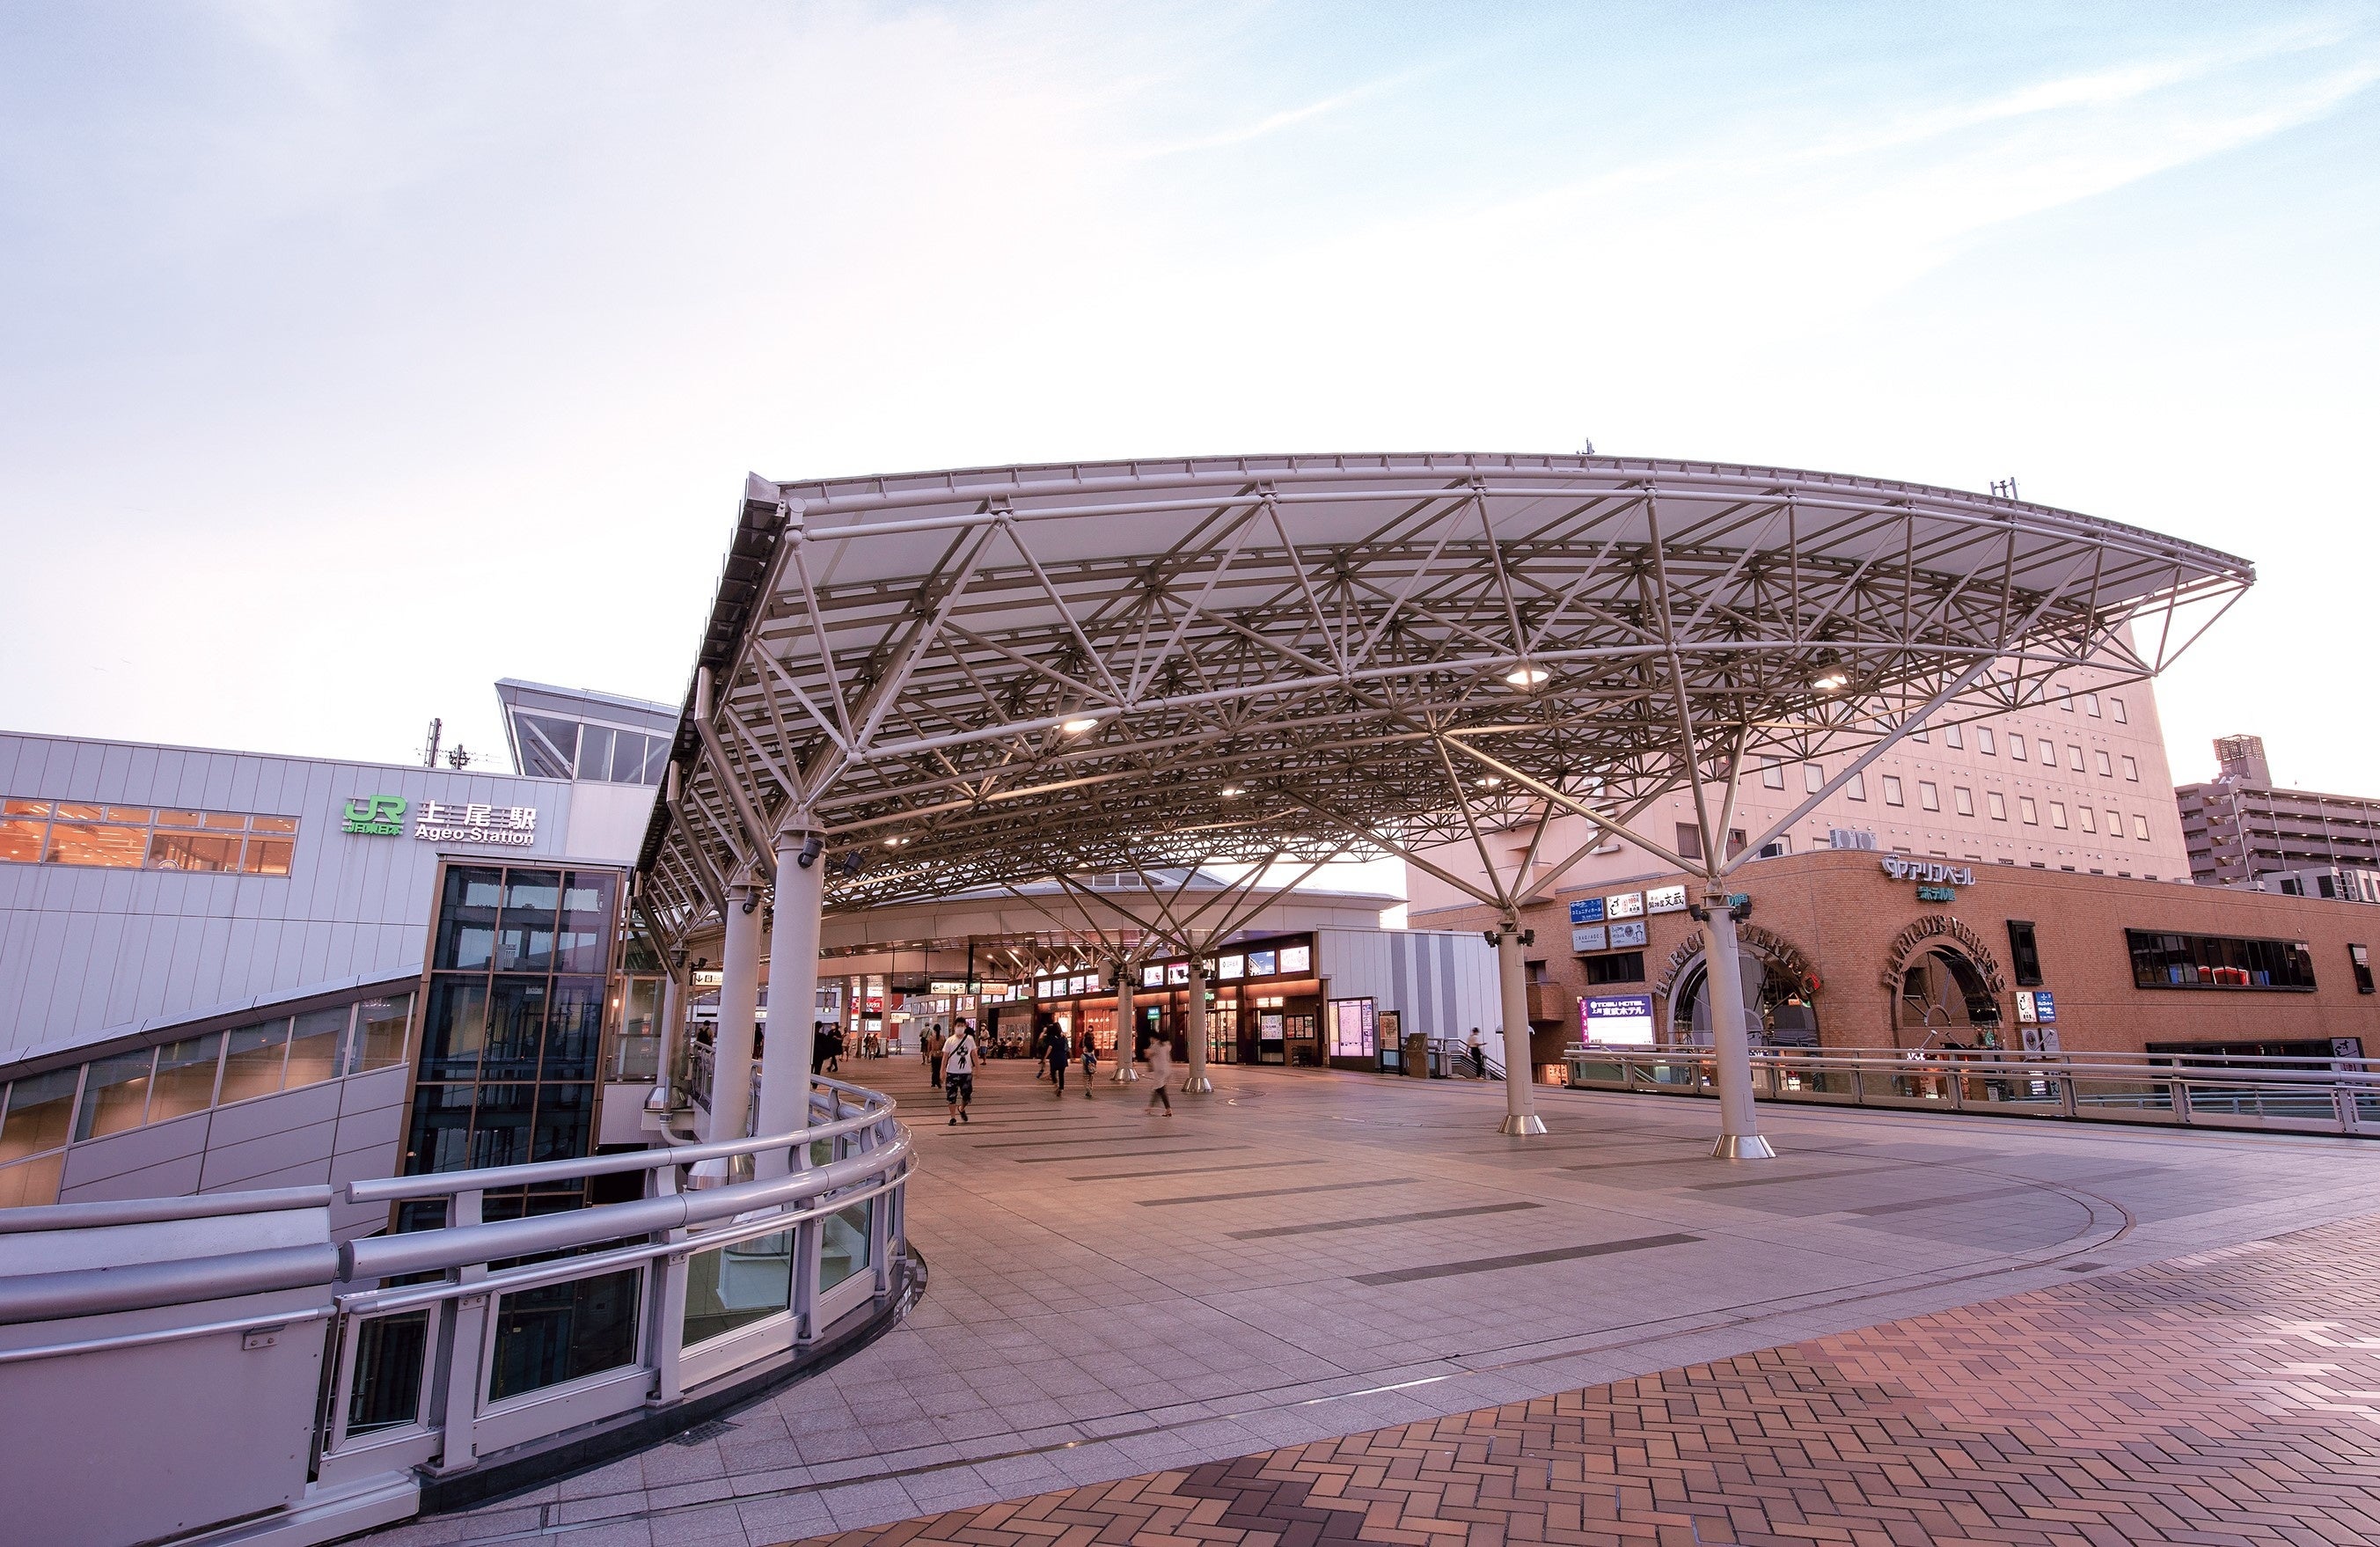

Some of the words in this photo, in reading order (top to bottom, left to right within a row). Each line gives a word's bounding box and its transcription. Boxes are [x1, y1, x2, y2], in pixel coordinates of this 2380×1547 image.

[345, 795, 407, 825] JR
[416, 799, 537, 831] 上尾駅
[343, 822, 401, 836] JR東日本
[414, 824, 465, 842] Ageo
[469, 826, 534, 845] Station
